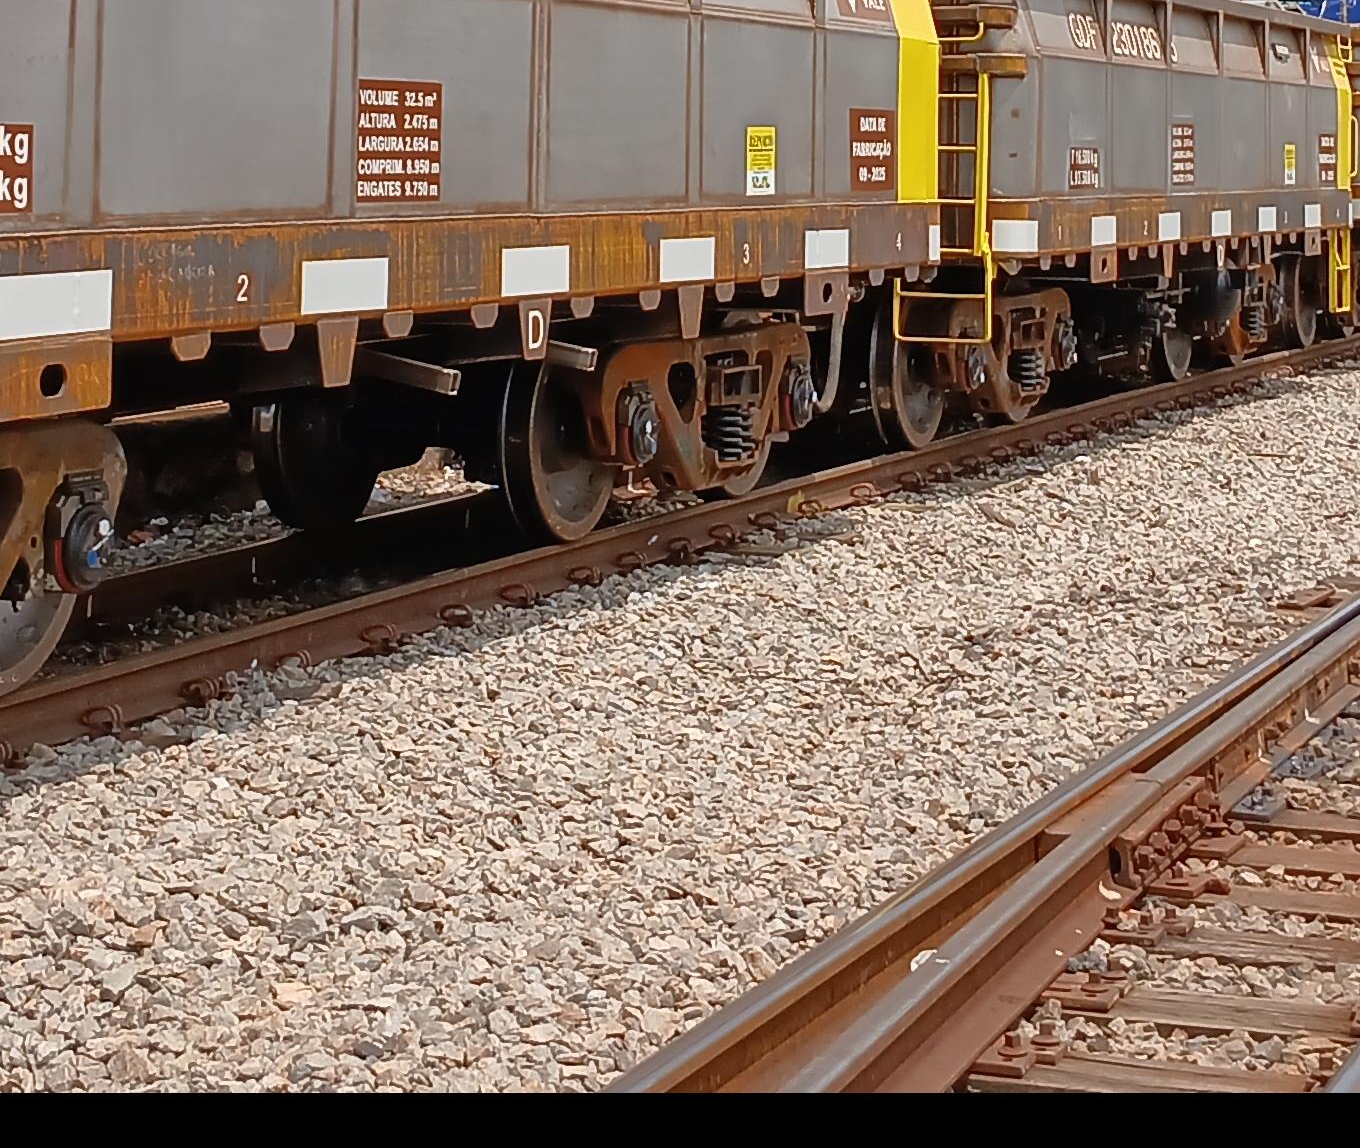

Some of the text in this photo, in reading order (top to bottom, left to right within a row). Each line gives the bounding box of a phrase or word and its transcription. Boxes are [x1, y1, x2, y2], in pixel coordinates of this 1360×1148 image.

[1068, 13, 1097, 50] GDF
[360, 89, 399, 106] VOLUME
[404, 91, 424, 107] 32.5
[359, 111, 396, 129] ALTURA
[429, 118, 438, 129] m
[860, 116, 876, 132] DATA
[359, 135, 404, 152] LARGURA
[430, 140, 439, 152] m
[431, 162, 440, 174] m
[357, 180, 401, 197] ENGATES
[429, 184, 438, 196] m
[895, 231, 902, 251] 4
[743, 243, 750, 264] 3
[236, 274, 249, 302] 2
[528, 309, 544, 350] D
